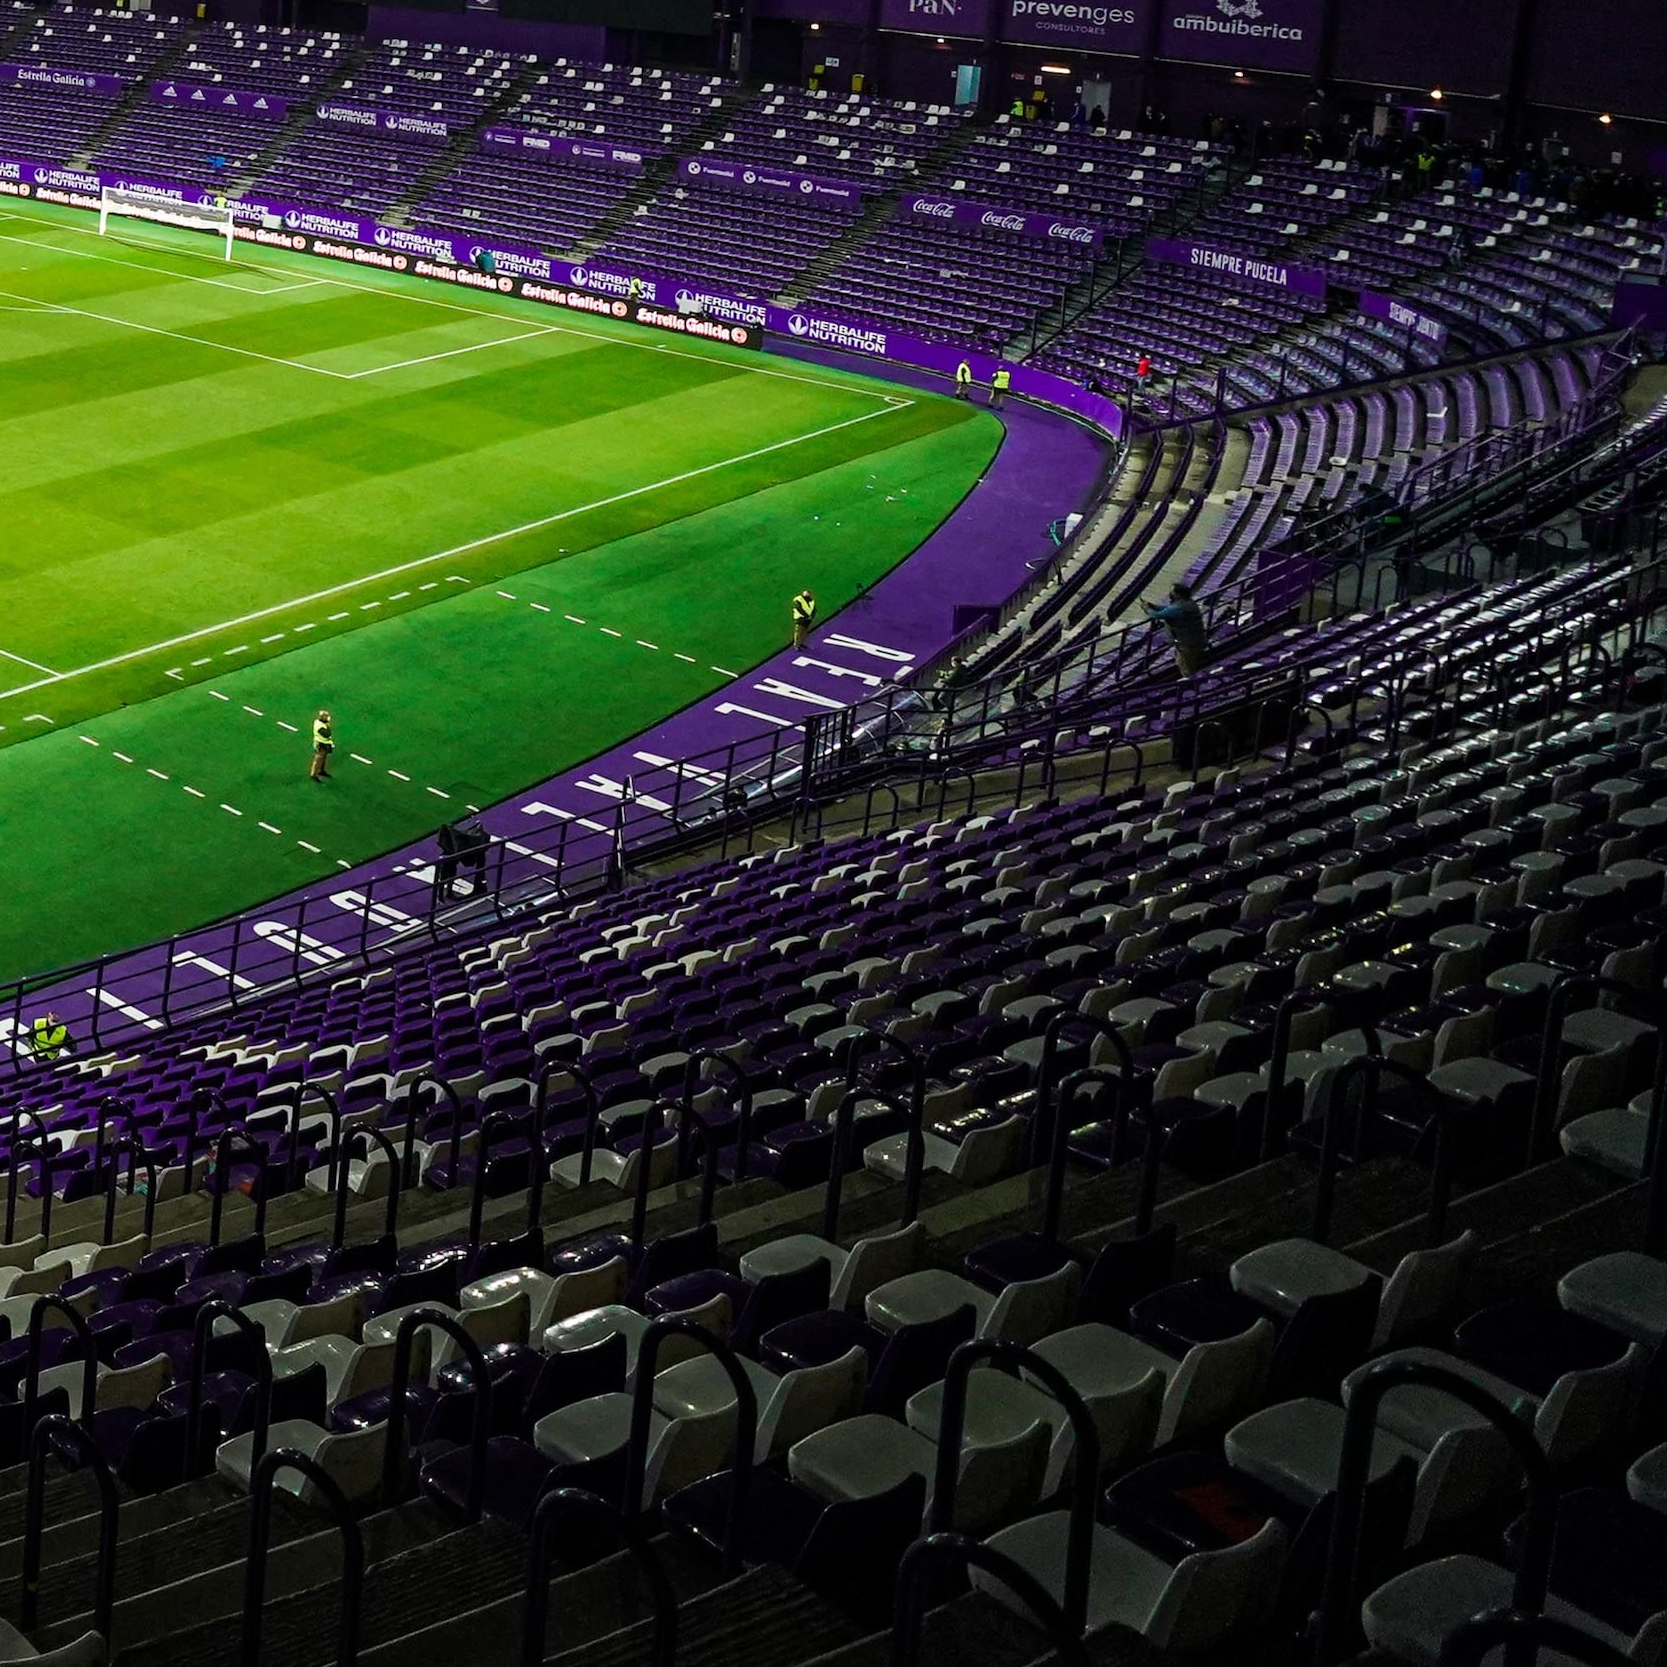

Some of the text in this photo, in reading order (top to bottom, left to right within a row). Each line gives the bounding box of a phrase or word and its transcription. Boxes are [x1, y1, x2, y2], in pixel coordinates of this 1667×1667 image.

[1013, 0, 1135, 25] prevenges
[1035, 21, 1106, 35] CONSULTORES
[1174, 16, 1303, 40] ambuiberica
[17, 69, 85, 86] Estrella Galicia
[329, 106, 377, 120] HERBALIFE
[329, 114, 377, 126] NUTRITION
[399, 116, 447, 130] HERBALIFE
[398, 124, 447, 137] NUTRITION
[49, 170, 101, 185] HERBALIFE
[49, 176, 101, 192] NUTRITION
[301, 214, 359, 232] HERBALIFE
[301, 221, 359, 240] NUTRITION
[391, 230, 452, 250] HERBALIFE
[391, 238, 451, 260] NUTRITION
[495, 259, 551, 279] UTRITION
[1191, 248, 1287, 286] SIEMPRE PUCELA
[521, 282, 611, 314] Estrella Galicia
[695, 292, 767, 317] HERBALIFE
[637, 308, 731, 342] Estrella Galicia
[809, 318, 887, 344] HERBALIFE
[809, 328, 885, 354] NUTRITION
